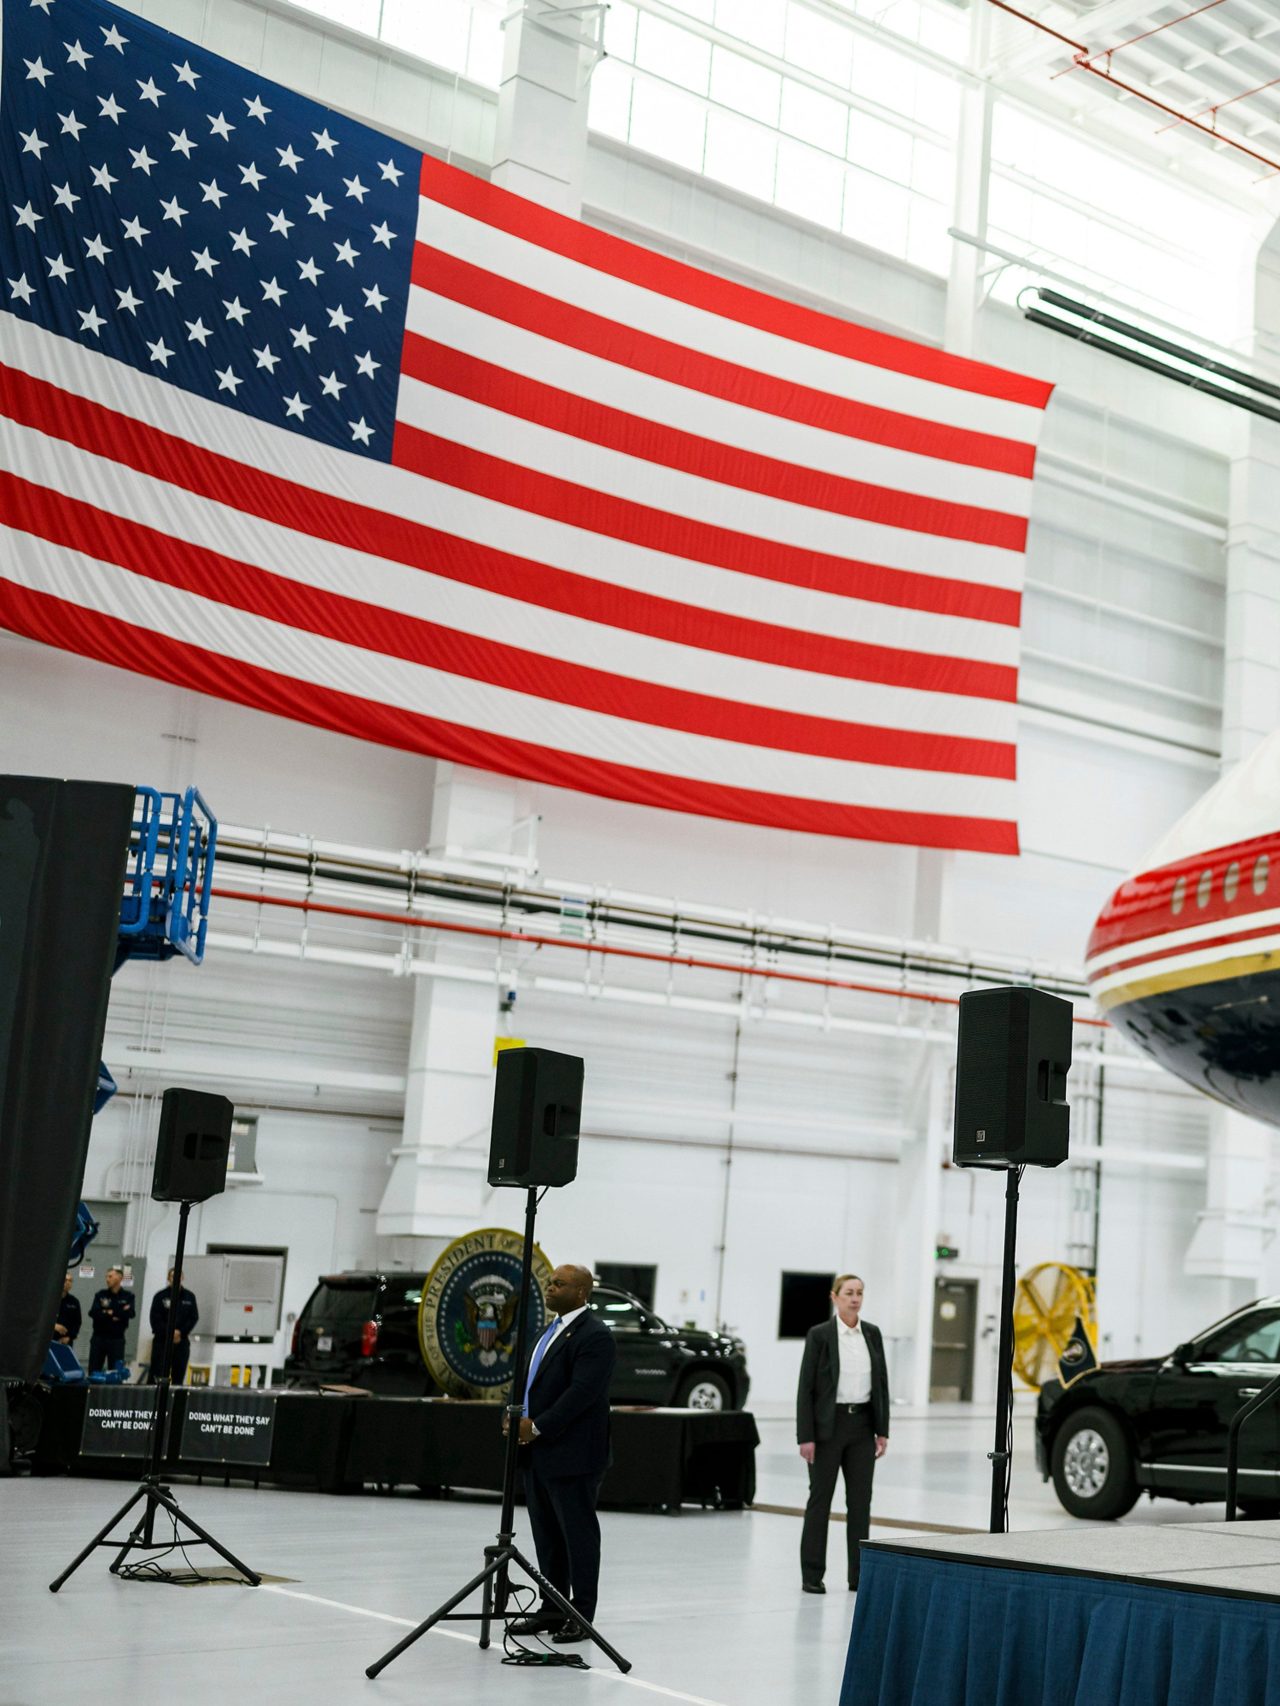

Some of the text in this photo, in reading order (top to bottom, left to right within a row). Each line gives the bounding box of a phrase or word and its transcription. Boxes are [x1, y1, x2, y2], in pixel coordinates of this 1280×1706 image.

[426, 1234, 497, 1308] PRESIDENT
[89, 1408, 112, 1418] DOING
[113, 1409, 134, 1418] WHAT
[134, 1410, 153, 1419] THEY
[188, 1411, 270, 1426] DOING WHAT THEY SAY
[101, 1420, 153, 1430] CAN'T BE DON
[200, 1423, 255, 1436] CAN'T BE DONE
